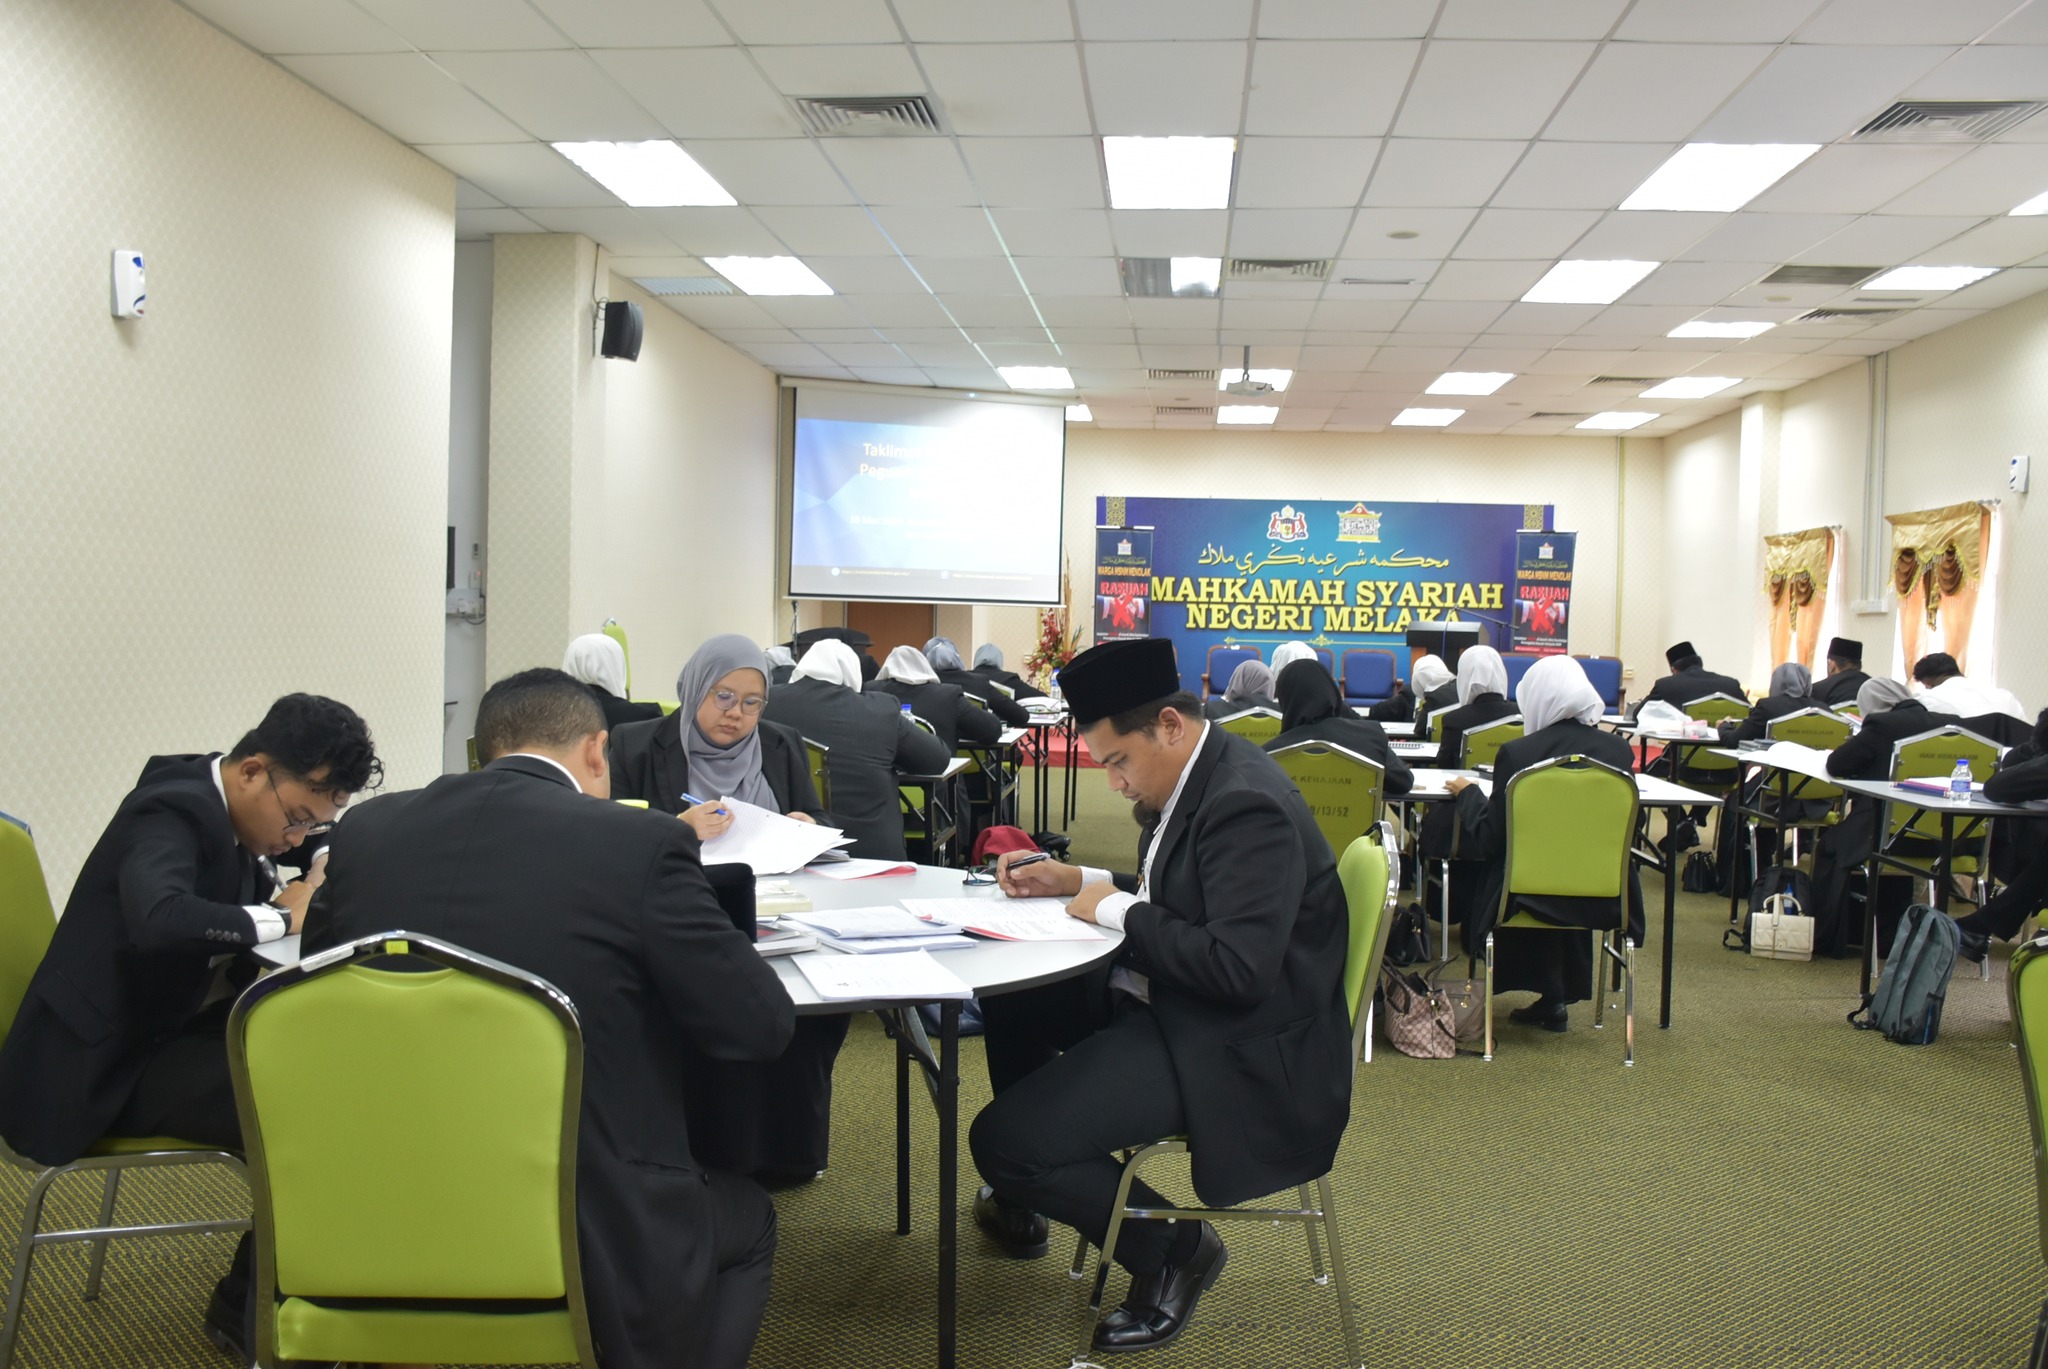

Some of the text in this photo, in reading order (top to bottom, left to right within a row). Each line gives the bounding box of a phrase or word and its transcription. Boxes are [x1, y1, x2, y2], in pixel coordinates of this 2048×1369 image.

[863, 443, 921, 460] Taklim
[1151, 576, 1504, 609] MAHKAMAH SYARIAH
[1186, 603, 1313, 631] NEGERI
